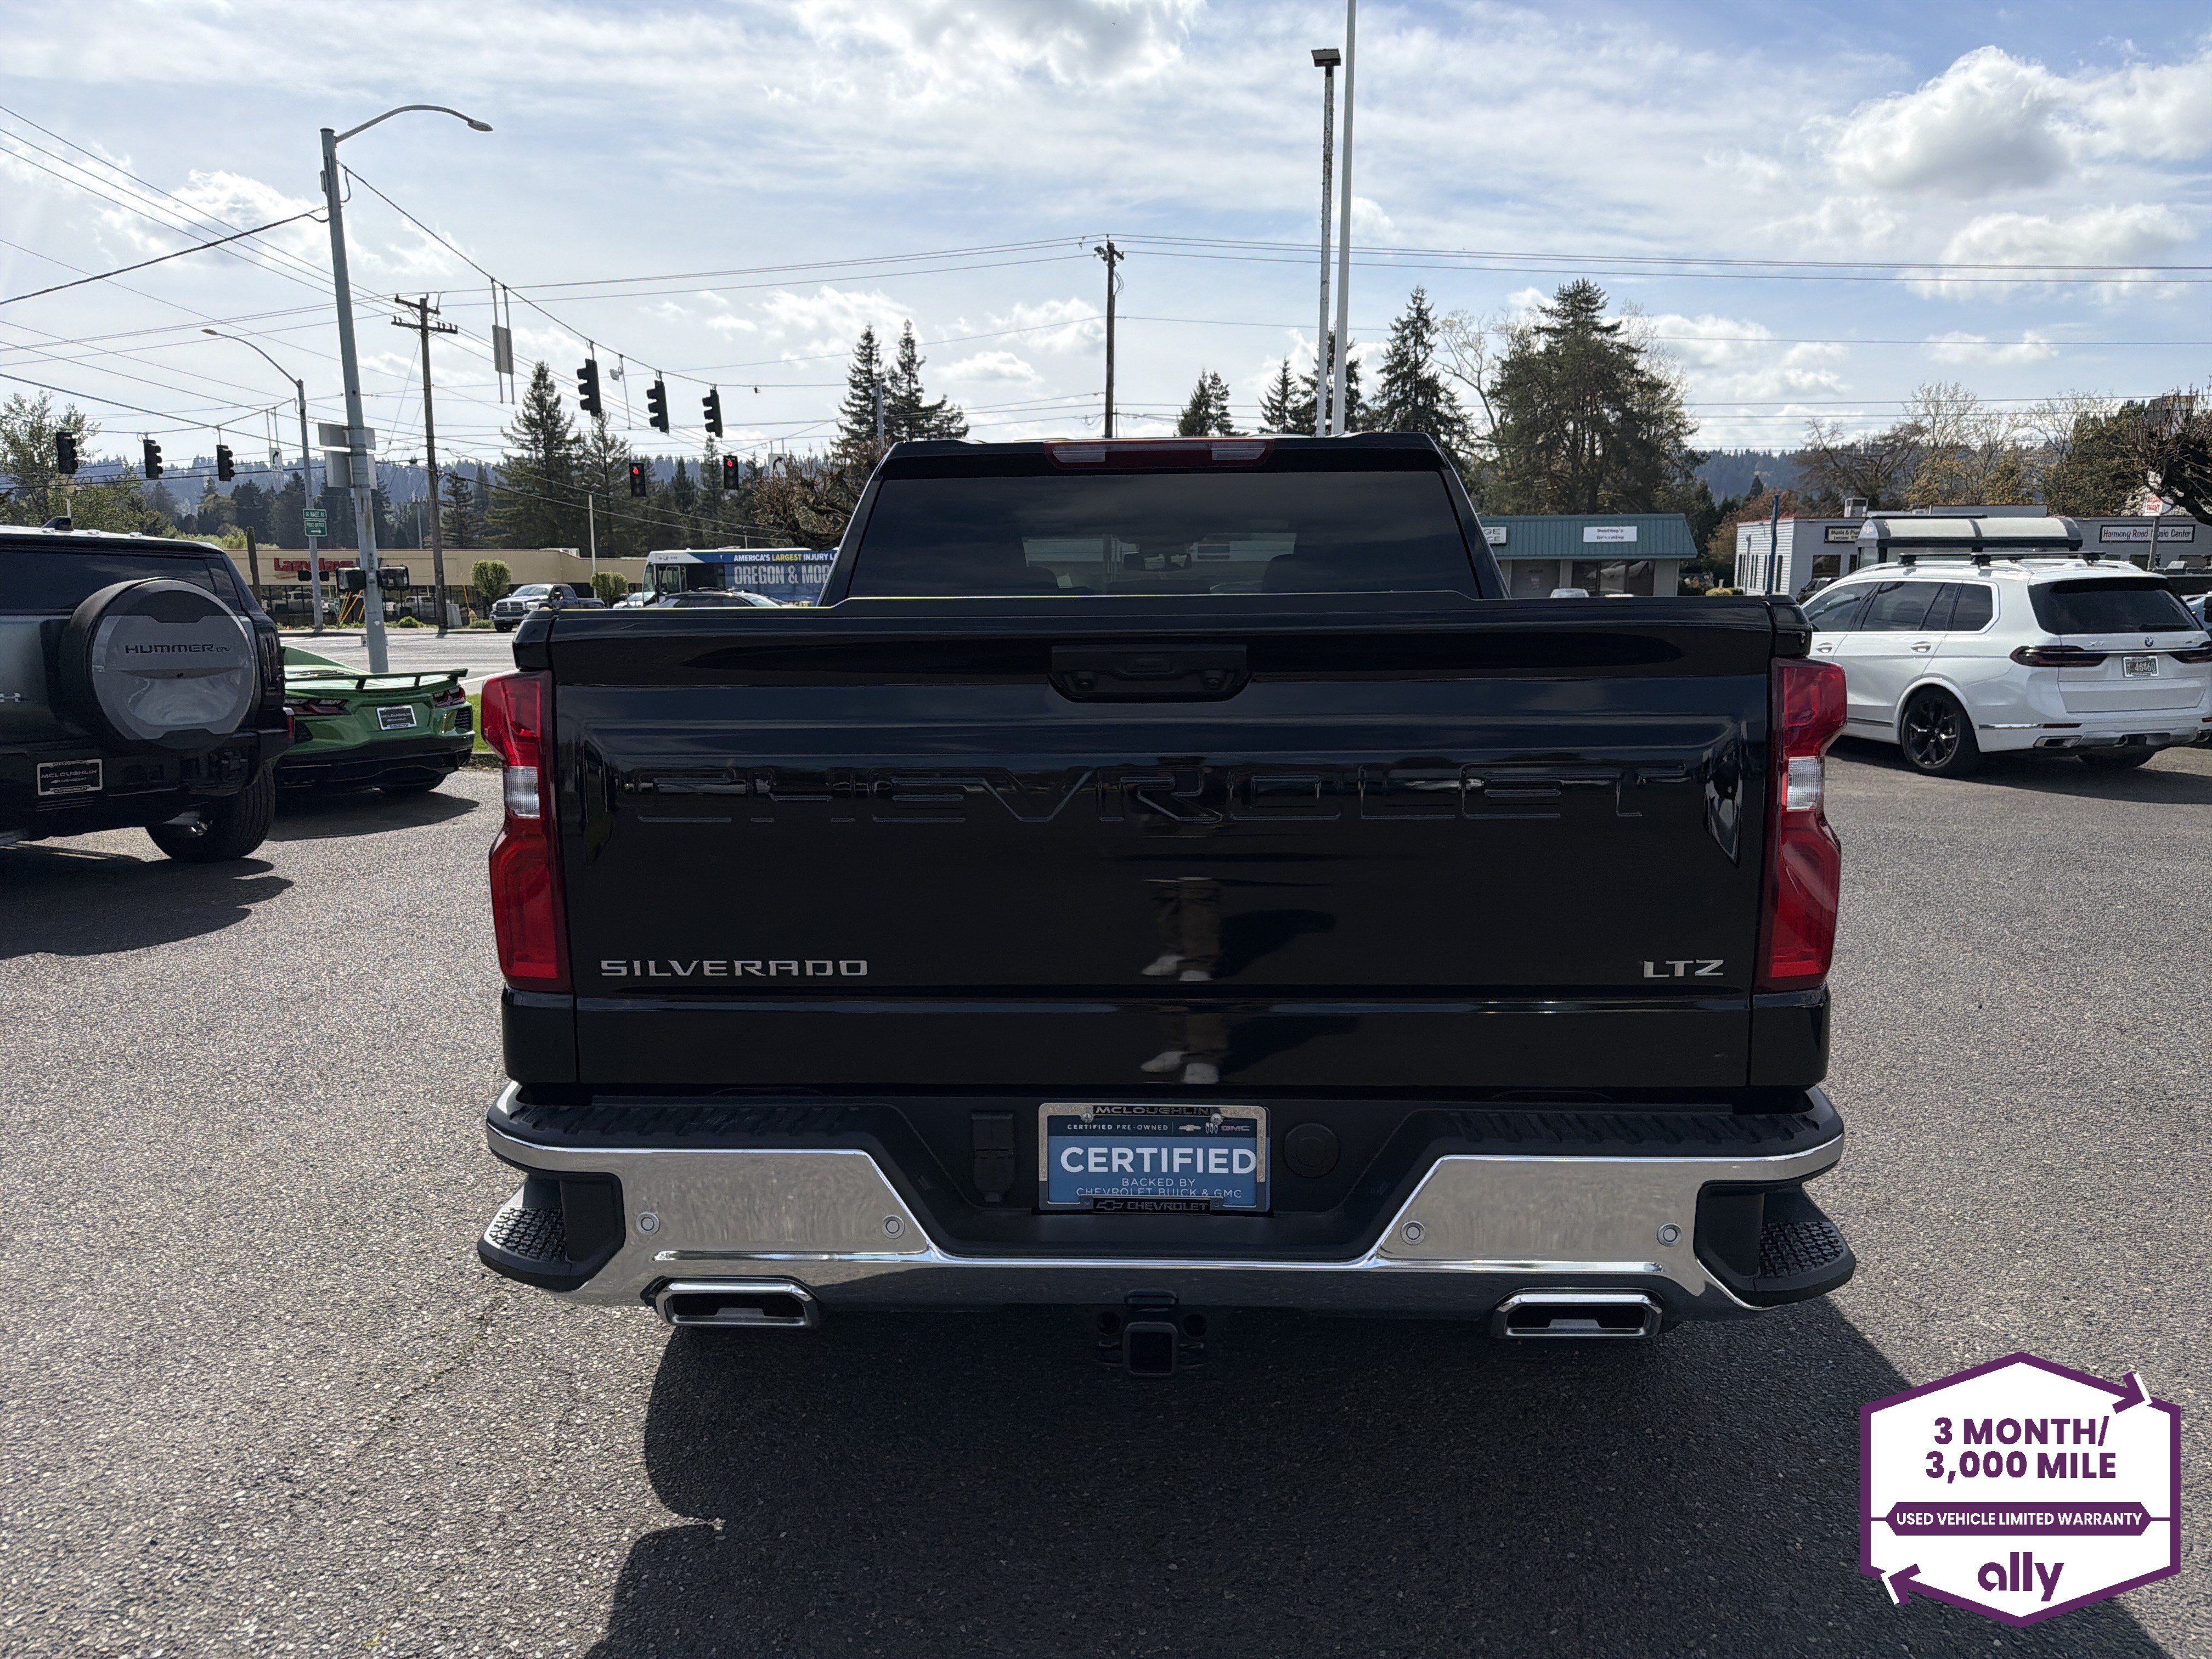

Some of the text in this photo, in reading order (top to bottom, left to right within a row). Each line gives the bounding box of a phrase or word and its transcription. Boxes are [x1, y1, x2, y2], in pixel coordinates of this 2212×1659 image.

[2103, 529, 2131, 540] Harmony
[2132, 529, 2148, 538] Road
[2170, 528, 2191, 538] Center
[733, 554, 771, 562] AMERICA'S
[734, 565, 785, 585] OREGON
[788, 565, 799, 584] &
[125, 644, 214, 653] HUMMER
[41, 769, 98, 779] MCLOUGHLIN
[600, 959, 868, 977] SILVERADO
[1643, 959, 1724, 978] LTZ
[1095, 1106, 1210, 1116] MCLOUGHLIN
[1060, 1147, 1257, 1175] CERTIFIED
[1121, 1178, 1196, 1188] BACKED BY
[1076, 1187, 1242, 1199] CHEVROLET BUICK & GMC
[1127, 1201, 1209, 1211] CHEVROLET
